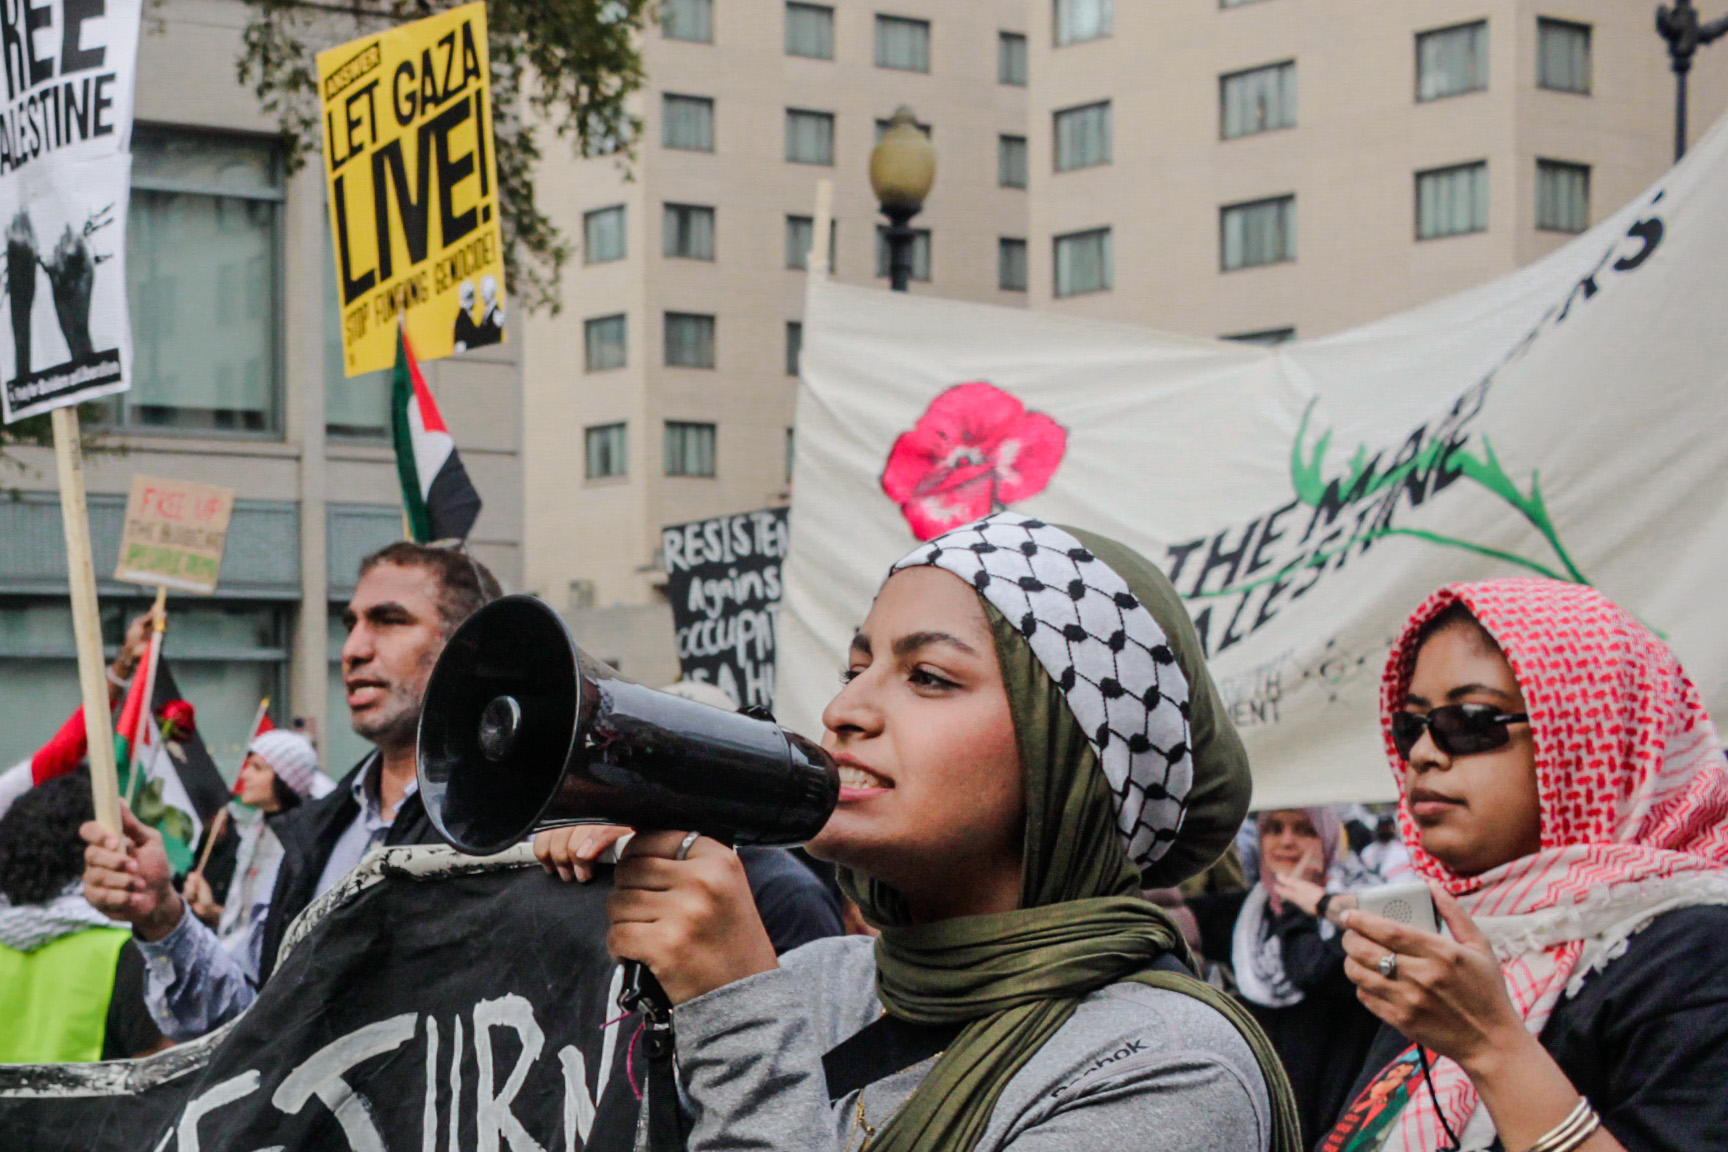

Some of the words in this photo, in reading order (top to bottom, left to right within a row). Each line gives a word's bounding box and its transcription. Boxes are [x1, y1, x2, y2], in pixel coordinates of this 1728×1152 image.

[328, 79, 379, 171] LET
[393, 20, 481, 127] GAZA
[333, 88, 491, 305] LIVE!
[1168, 499, 1300, 599] THE
